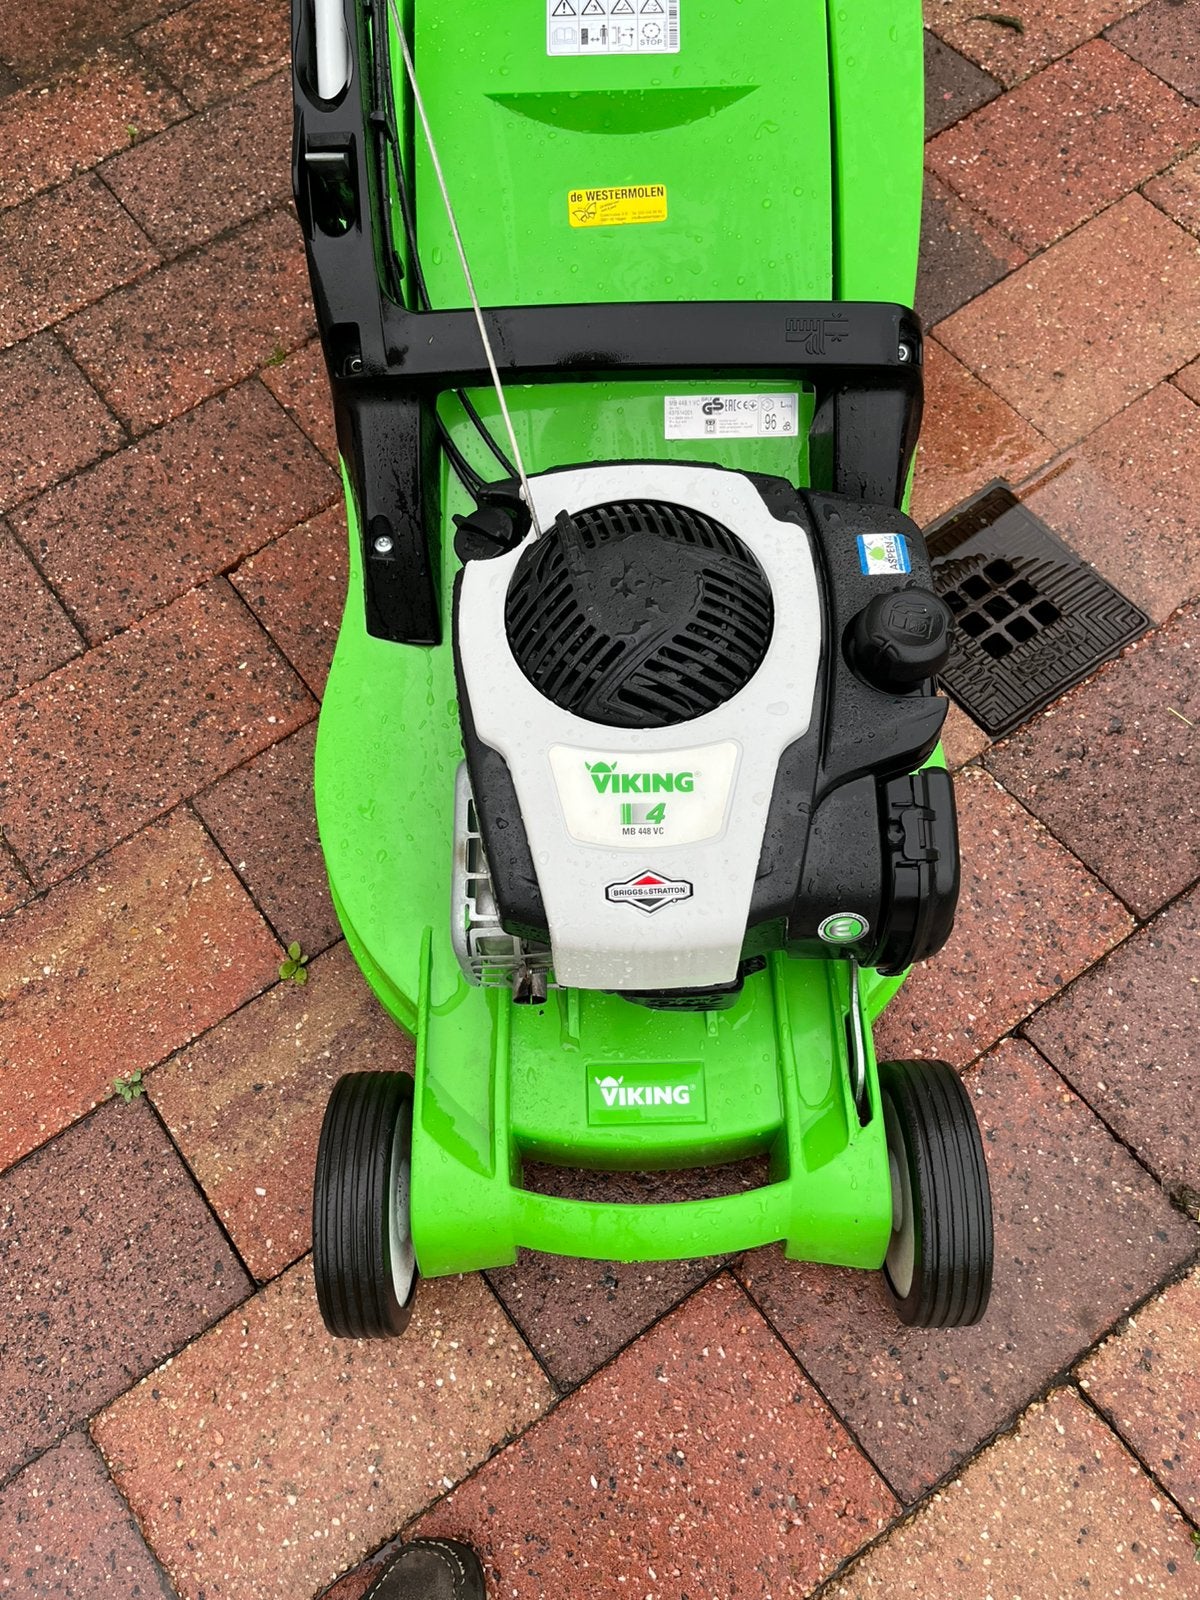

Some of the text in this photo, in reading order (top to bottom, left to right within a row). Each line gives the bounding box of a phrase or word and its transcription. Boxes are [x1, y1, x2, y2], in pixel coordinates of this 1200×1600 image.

[570, 186, 664, 202] de WESTERMOLEN
[765, 413, 777, 430] 96
[884, 541, 898, 571] ASPEN
[949, 641, 996, 694] VULC
[590, 771, 694, 794] VIKING
[645, 802, 667, 825] 4
[622, 826, 665, 835] MB 448 VC
[601, 1085, 690, 1106] VIKING
